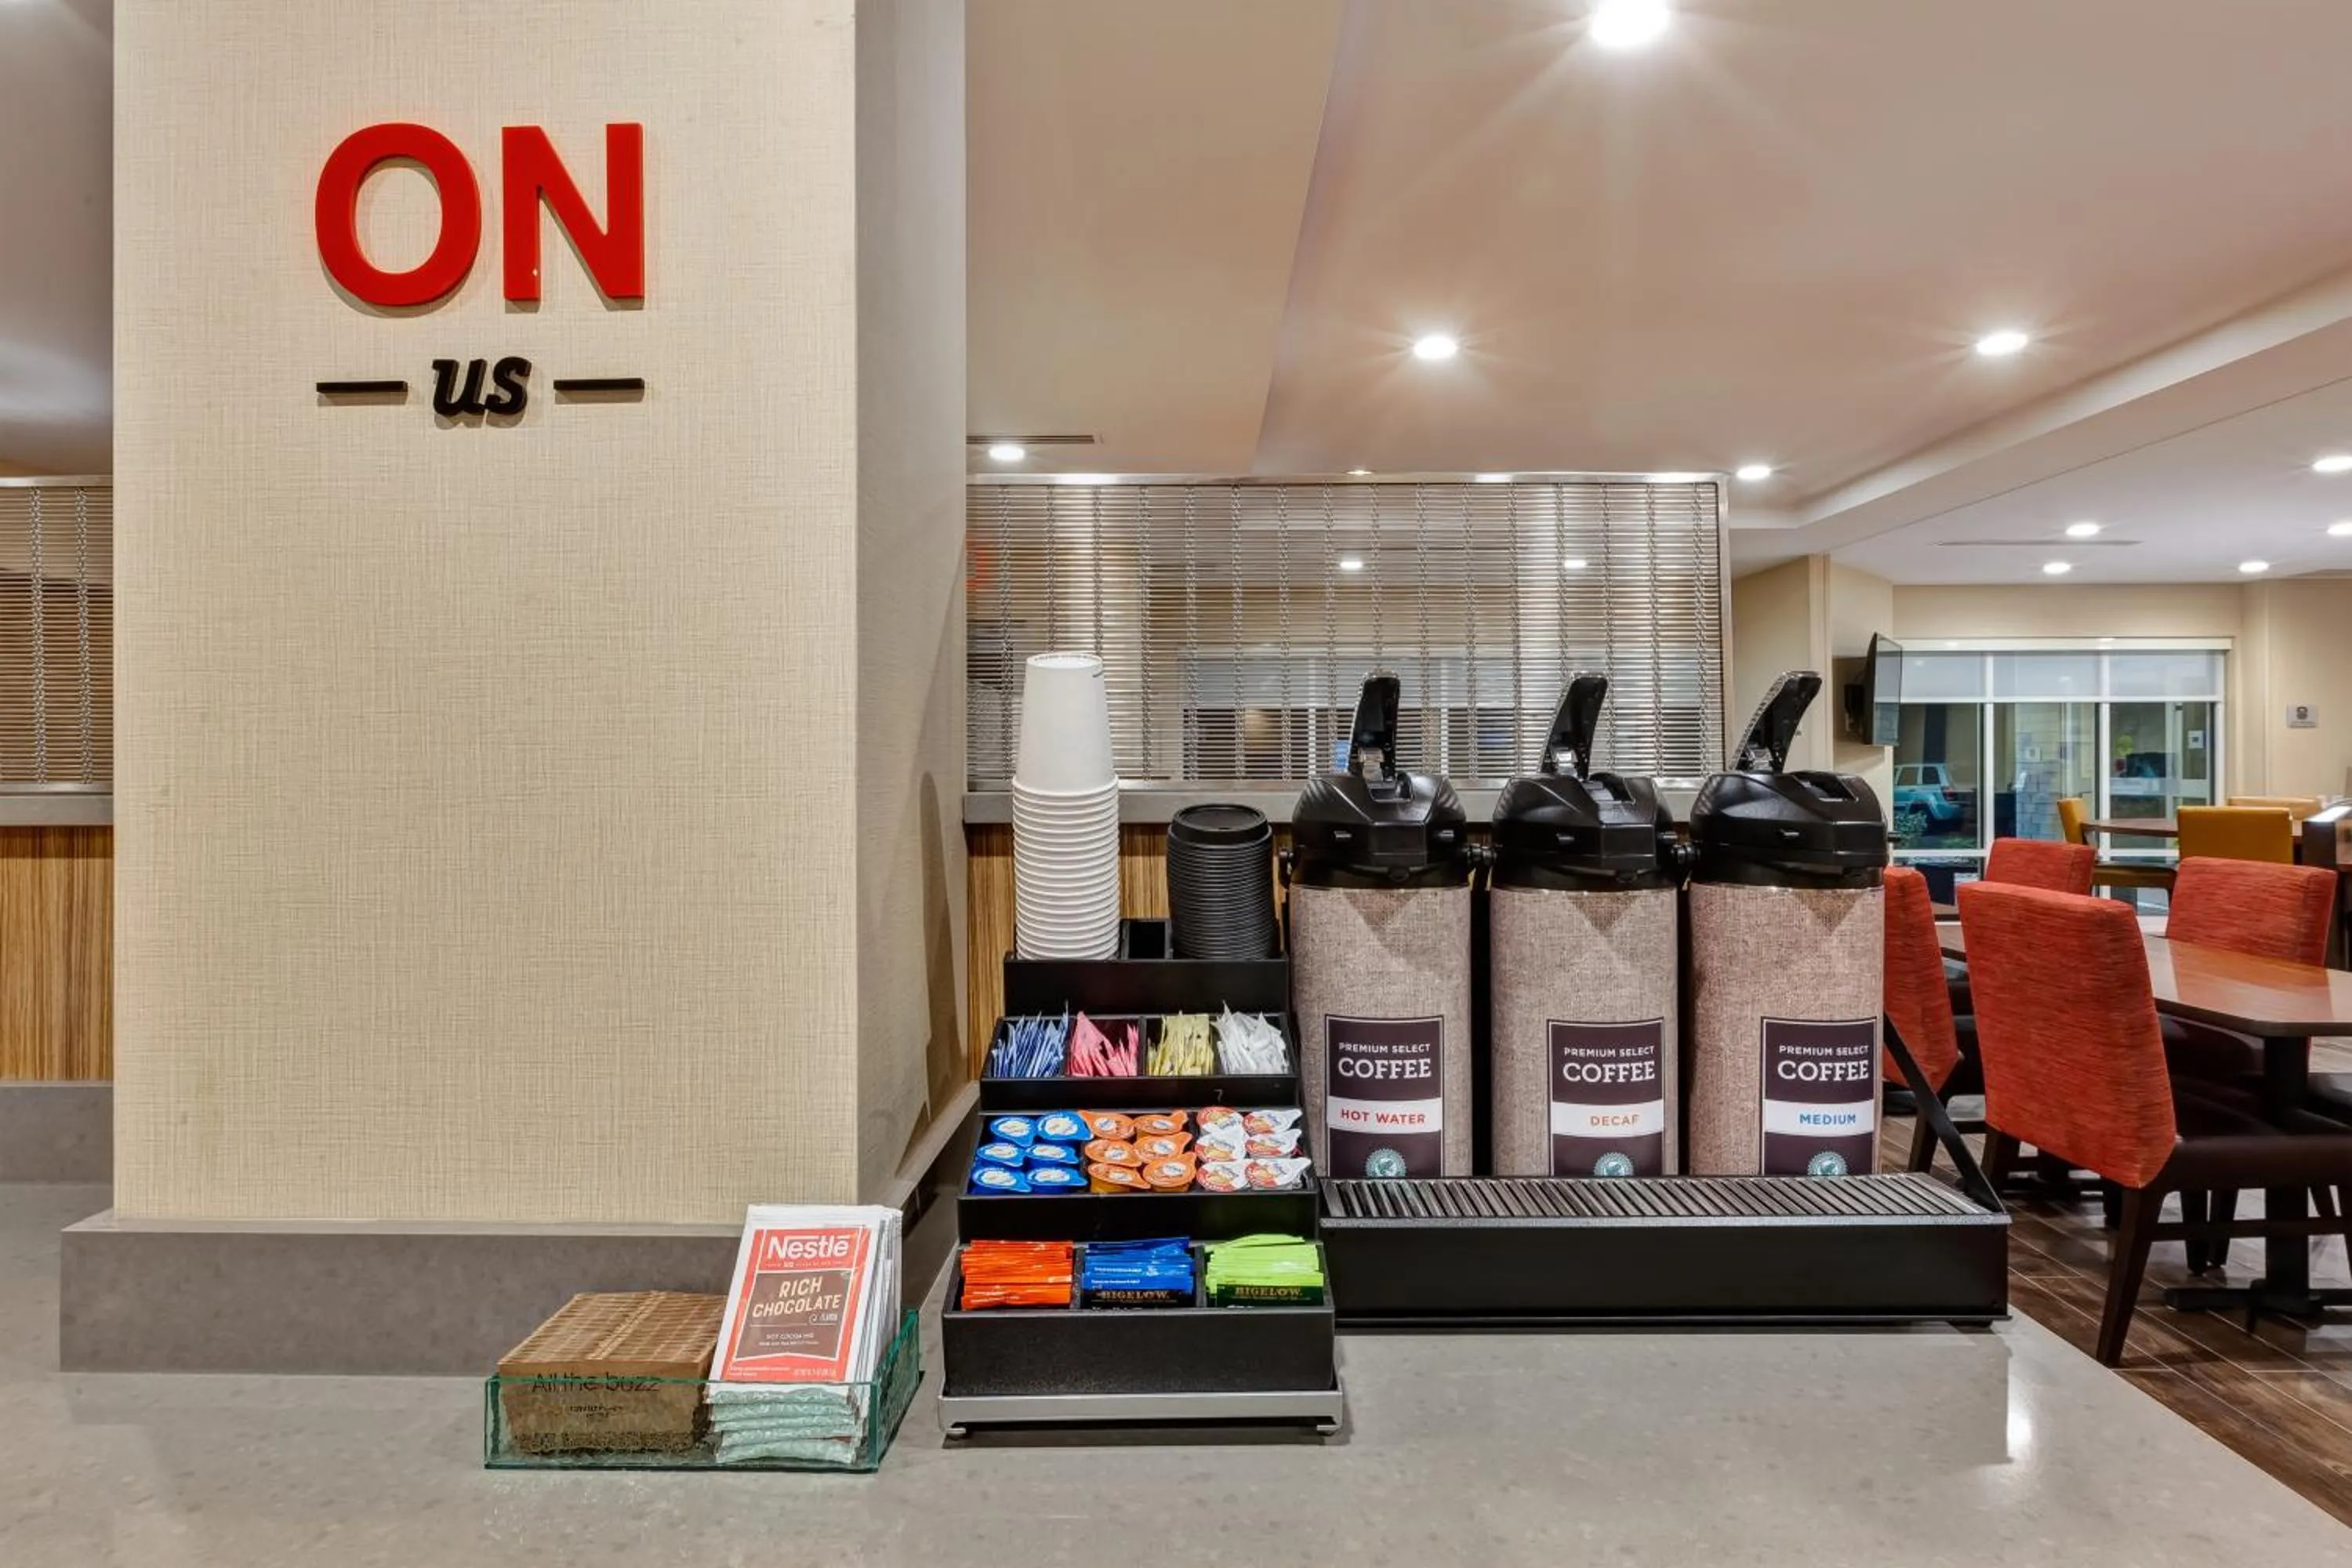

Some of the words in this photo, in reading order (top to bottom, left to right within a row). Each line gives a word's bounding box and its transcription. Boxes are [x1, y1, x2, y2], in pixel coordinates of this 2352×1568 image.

[315, 122, 645, 308] ON
[432, 356, 533, 417] us
[1338, 1042, 1388, 1054] PREMIUM
[1392, 1044, 1431, 1054] SELECT
[1564, 1047, 1616, 1058] PREMIUM
[1619, 1045, 1655, 1057] SELECT
[1779, 1044, 1832, 1056] PREMIUM
[1835, 1044, 1869, 1056] SELECT
[1338, 1057, 1432, 1080] COFFEE
[1563, 1060, 1656, 1083] COFFEE
[1777, 1059, 1869, 1081] COFFEE
[1341, 1108, 1370, 1122] HOT
[1375, 1112, 1426, 1124] WATER
[1590, 1114, 1640, 1127] DECAF
[1799, 1113, 1857, 1125] MEDIUM
[779, 1276, 823, 1298] RICH
[752, 1294, 842, 1318] CHOCOLATE
